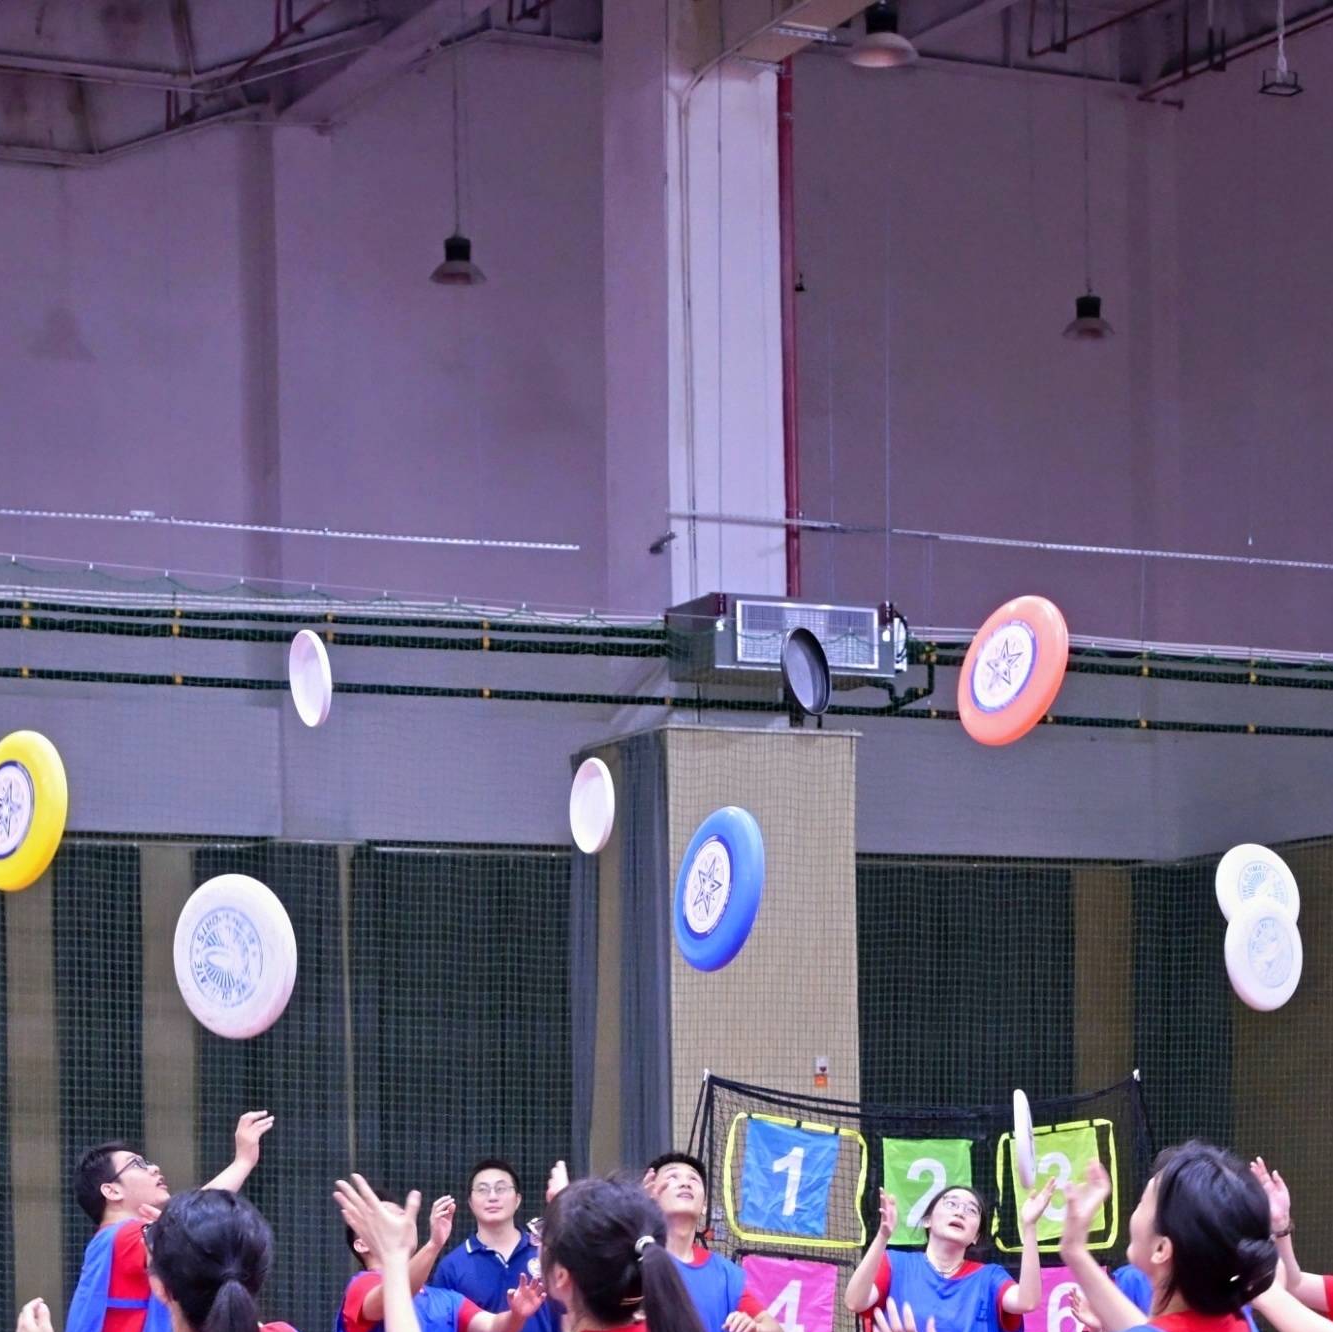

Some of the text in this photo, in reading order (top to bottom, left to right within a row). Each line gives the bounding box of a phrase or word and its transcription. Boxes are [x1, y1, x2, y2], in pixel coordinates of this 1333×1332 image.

[772, 1146, 804, 1217] 1
[907, 1158, 946, 1228] 2
[1038, 1151, 1071, 1221] 3
